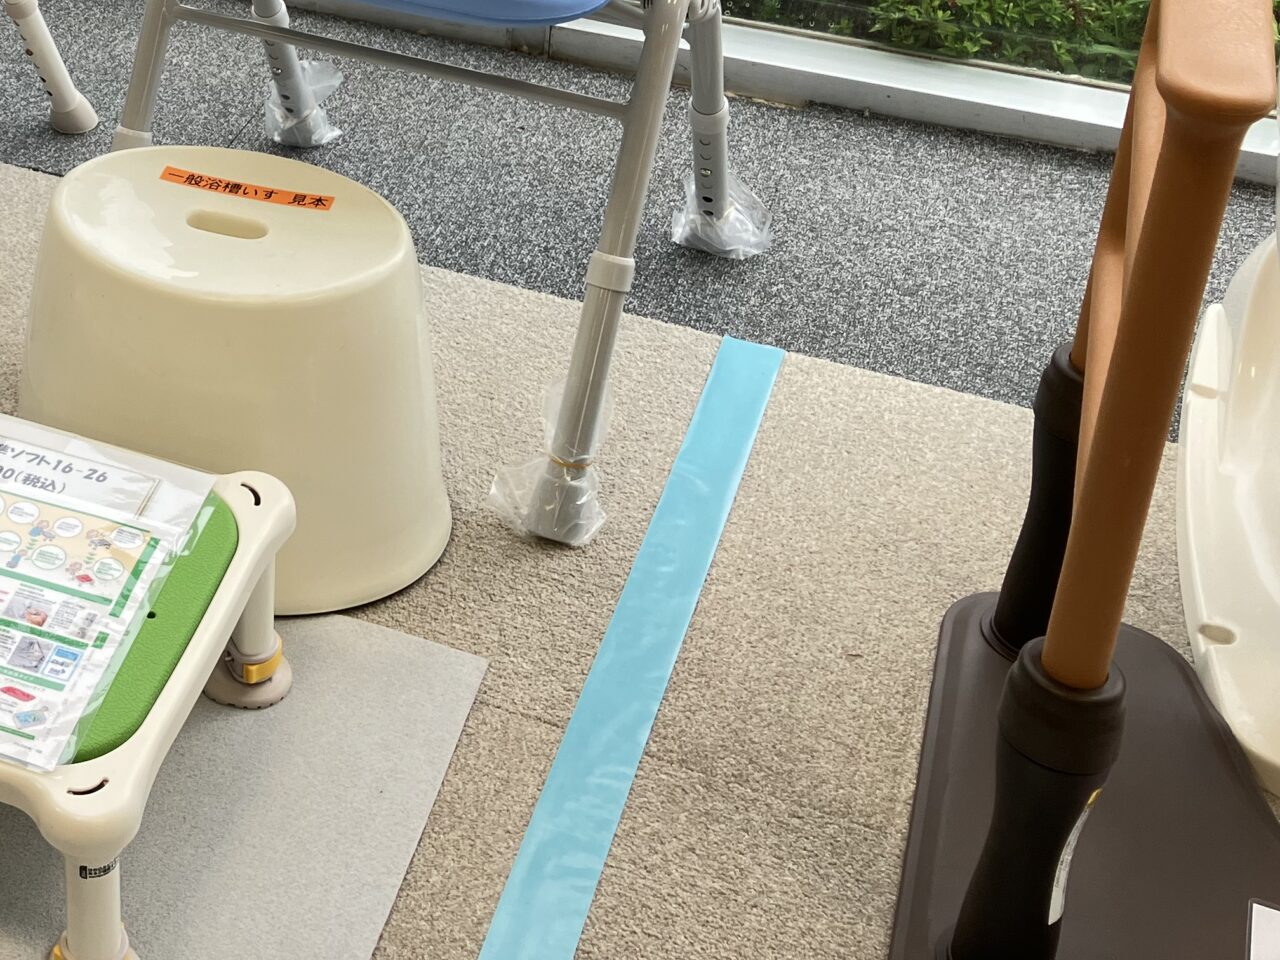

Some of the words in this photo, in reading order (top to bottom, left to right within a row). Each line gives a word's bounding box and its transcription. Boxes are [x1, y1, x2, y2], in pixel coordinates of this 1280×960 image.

[168, 172, 279, 201] 一般浴槽いす
[287, 193, 329, 208] 見本
